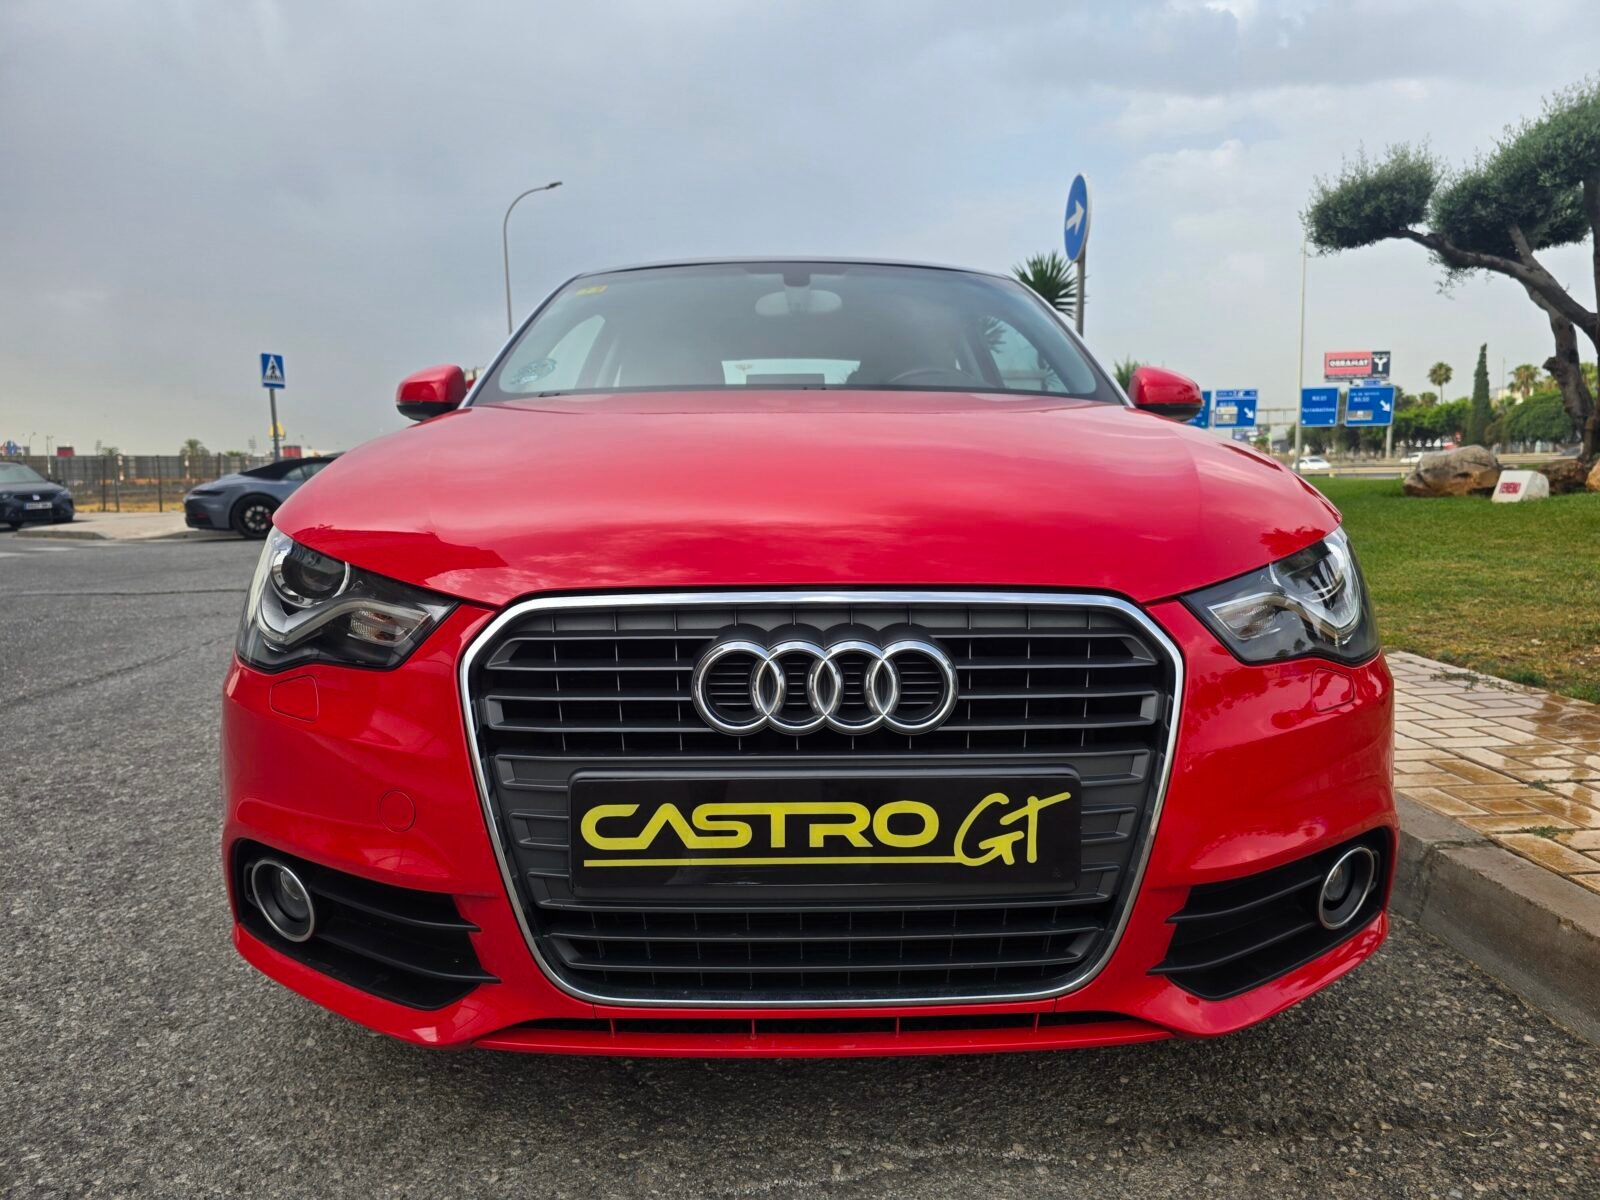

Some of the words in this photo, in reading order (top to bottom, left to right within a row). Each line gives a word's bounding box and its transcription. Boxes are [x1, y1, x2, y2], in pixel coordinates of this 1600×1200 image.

[1330, 359, 1369, 367] OBRAMAT
[580, 800, 940, 850] CASTRO
[954, 792, 1071, 867] GT
